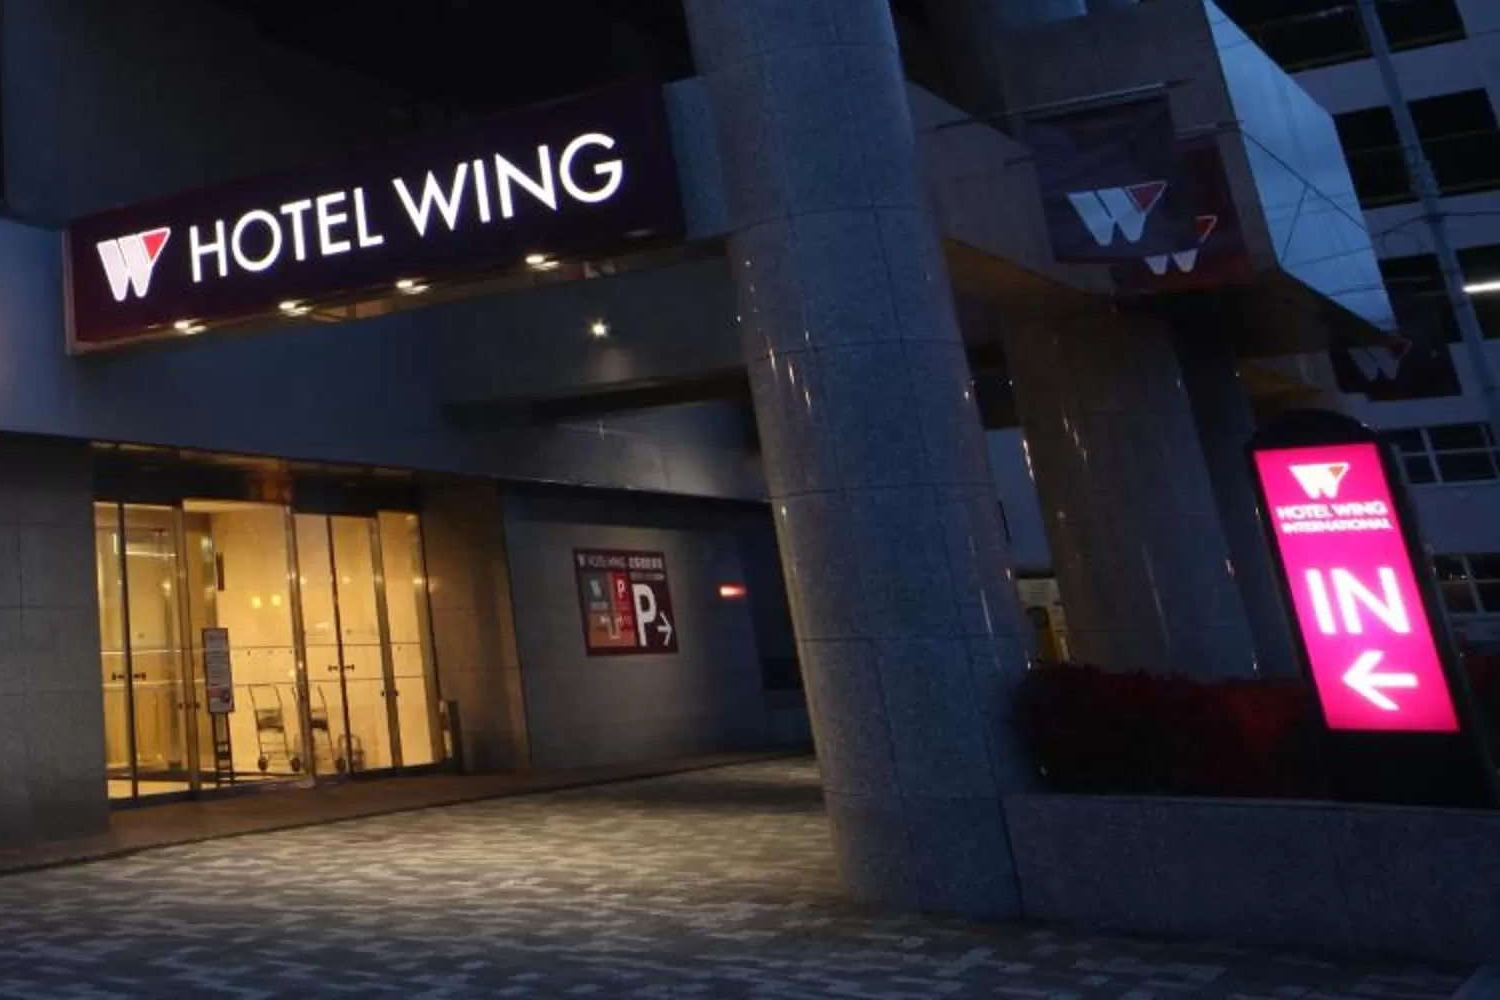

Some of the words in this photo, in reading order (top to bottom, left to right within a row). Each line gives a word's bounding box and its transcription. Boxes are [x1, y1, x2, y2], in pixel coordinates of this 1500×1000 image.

[190, 186, 384, 284] HOTEL
[392, 132, 624, 237] WING
[1276, 503, 1333, 520] HOTEL
[1331, 501, 1387, 517] WING
[1281, 518, 1393, 534] INTERNATIONAL
[631, 583, 657, 648] P
[1305, 567, 1411, 634] IN
